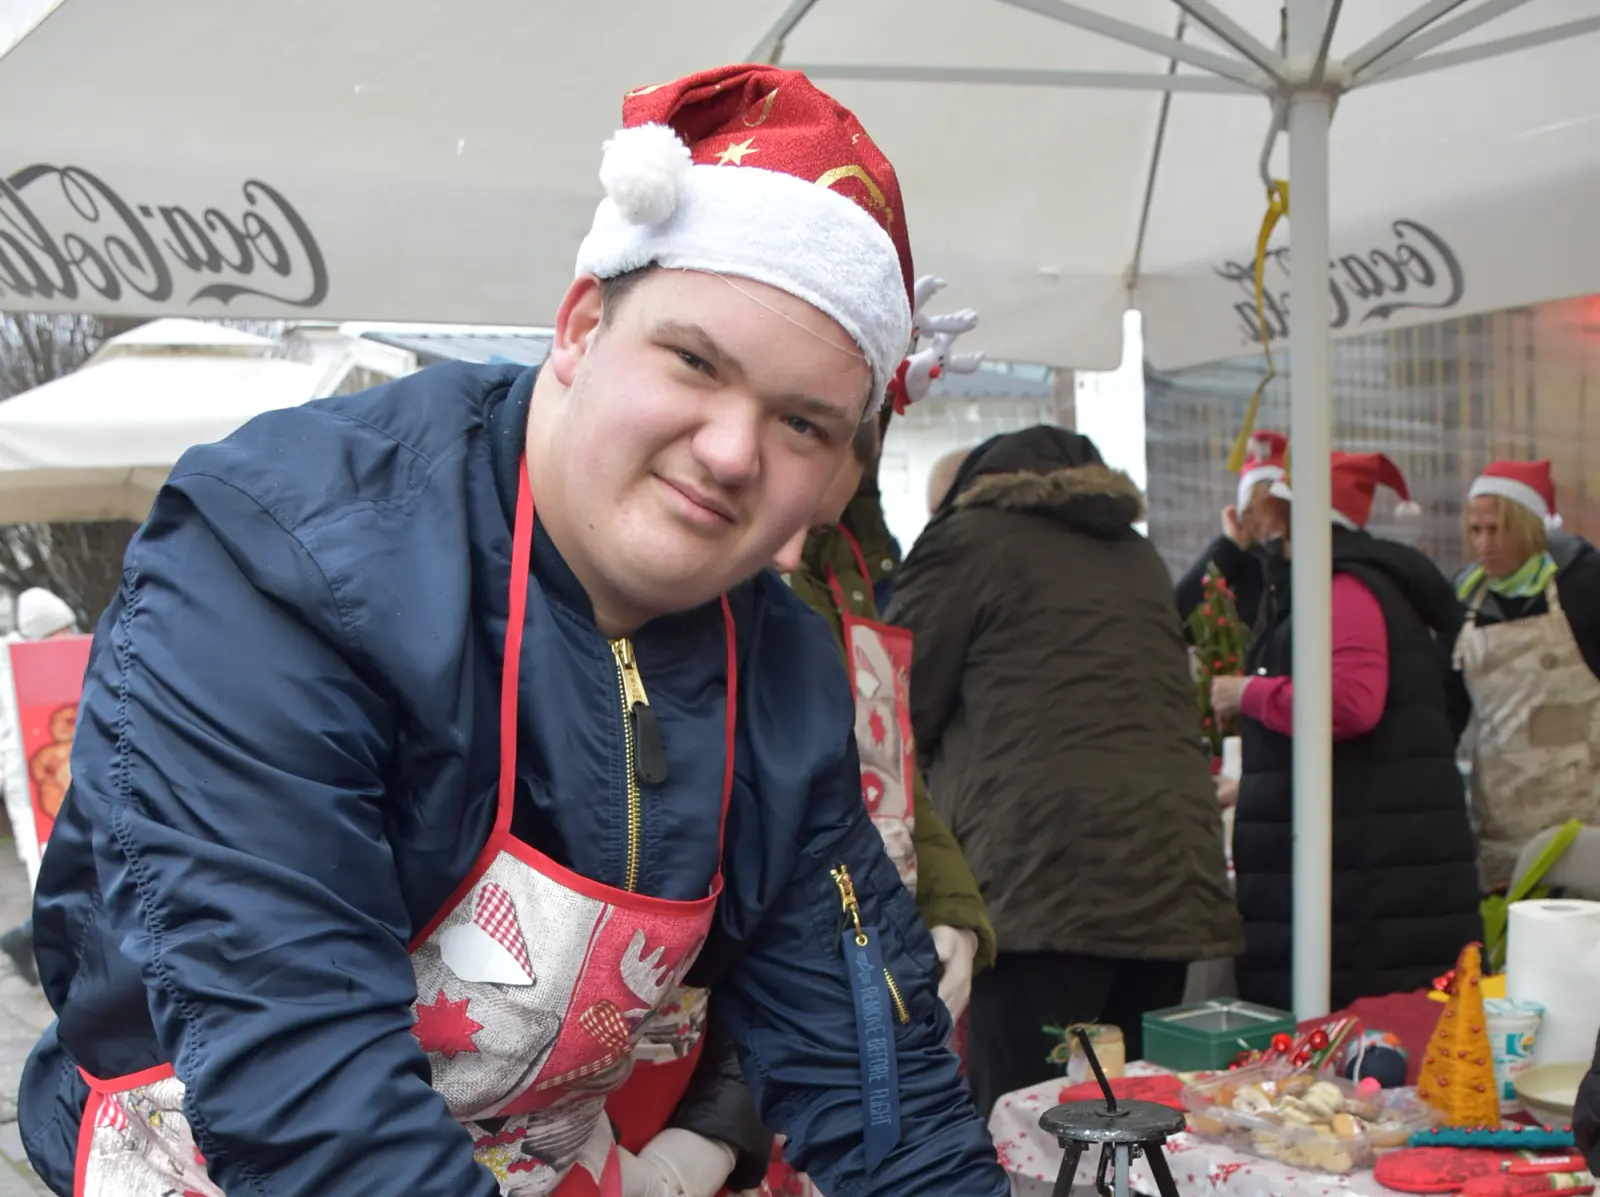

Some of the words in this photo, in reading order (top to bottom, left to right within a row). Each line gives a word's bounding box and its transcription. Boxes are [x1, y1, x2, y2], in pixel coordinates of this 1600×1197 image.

[861, 986, 885, 1035] REMOVE
[867, 1037, 889, 1083] BEFORE
[869, 1088, 891, 1126] FLIGHT
